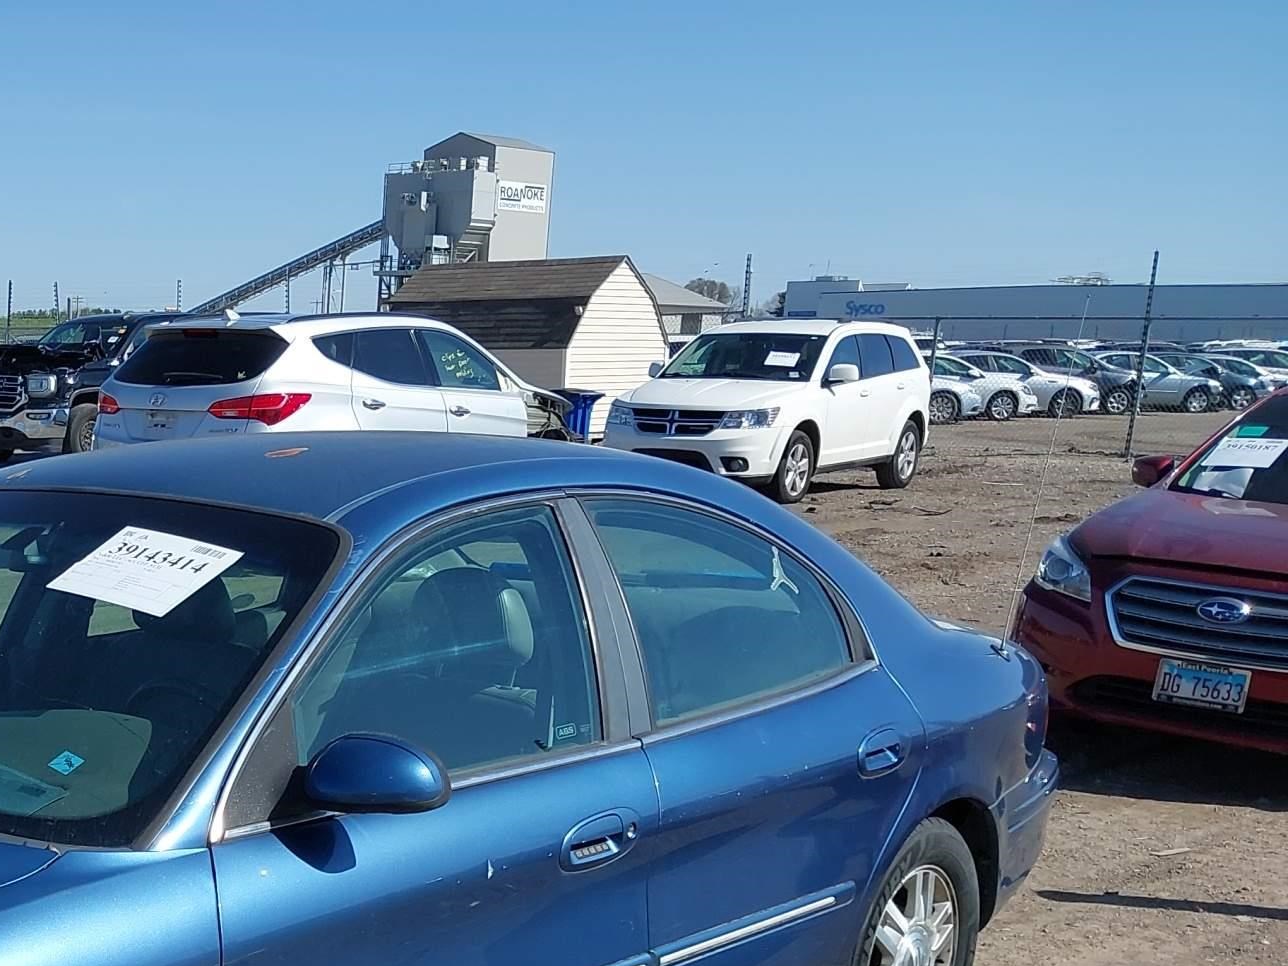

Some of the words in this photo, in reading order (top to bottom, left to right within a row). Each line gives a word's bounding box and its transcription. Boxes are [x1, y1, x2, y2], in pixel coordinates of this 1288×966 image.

[500, 186, 545, 201] ROANOKE
[845, 300, 885, 318] Sysco
[108, 541, 210, 574] 39143414
[1159, 671, 1183, 694] DG
[1192, 676, 1244, 703] 75633
